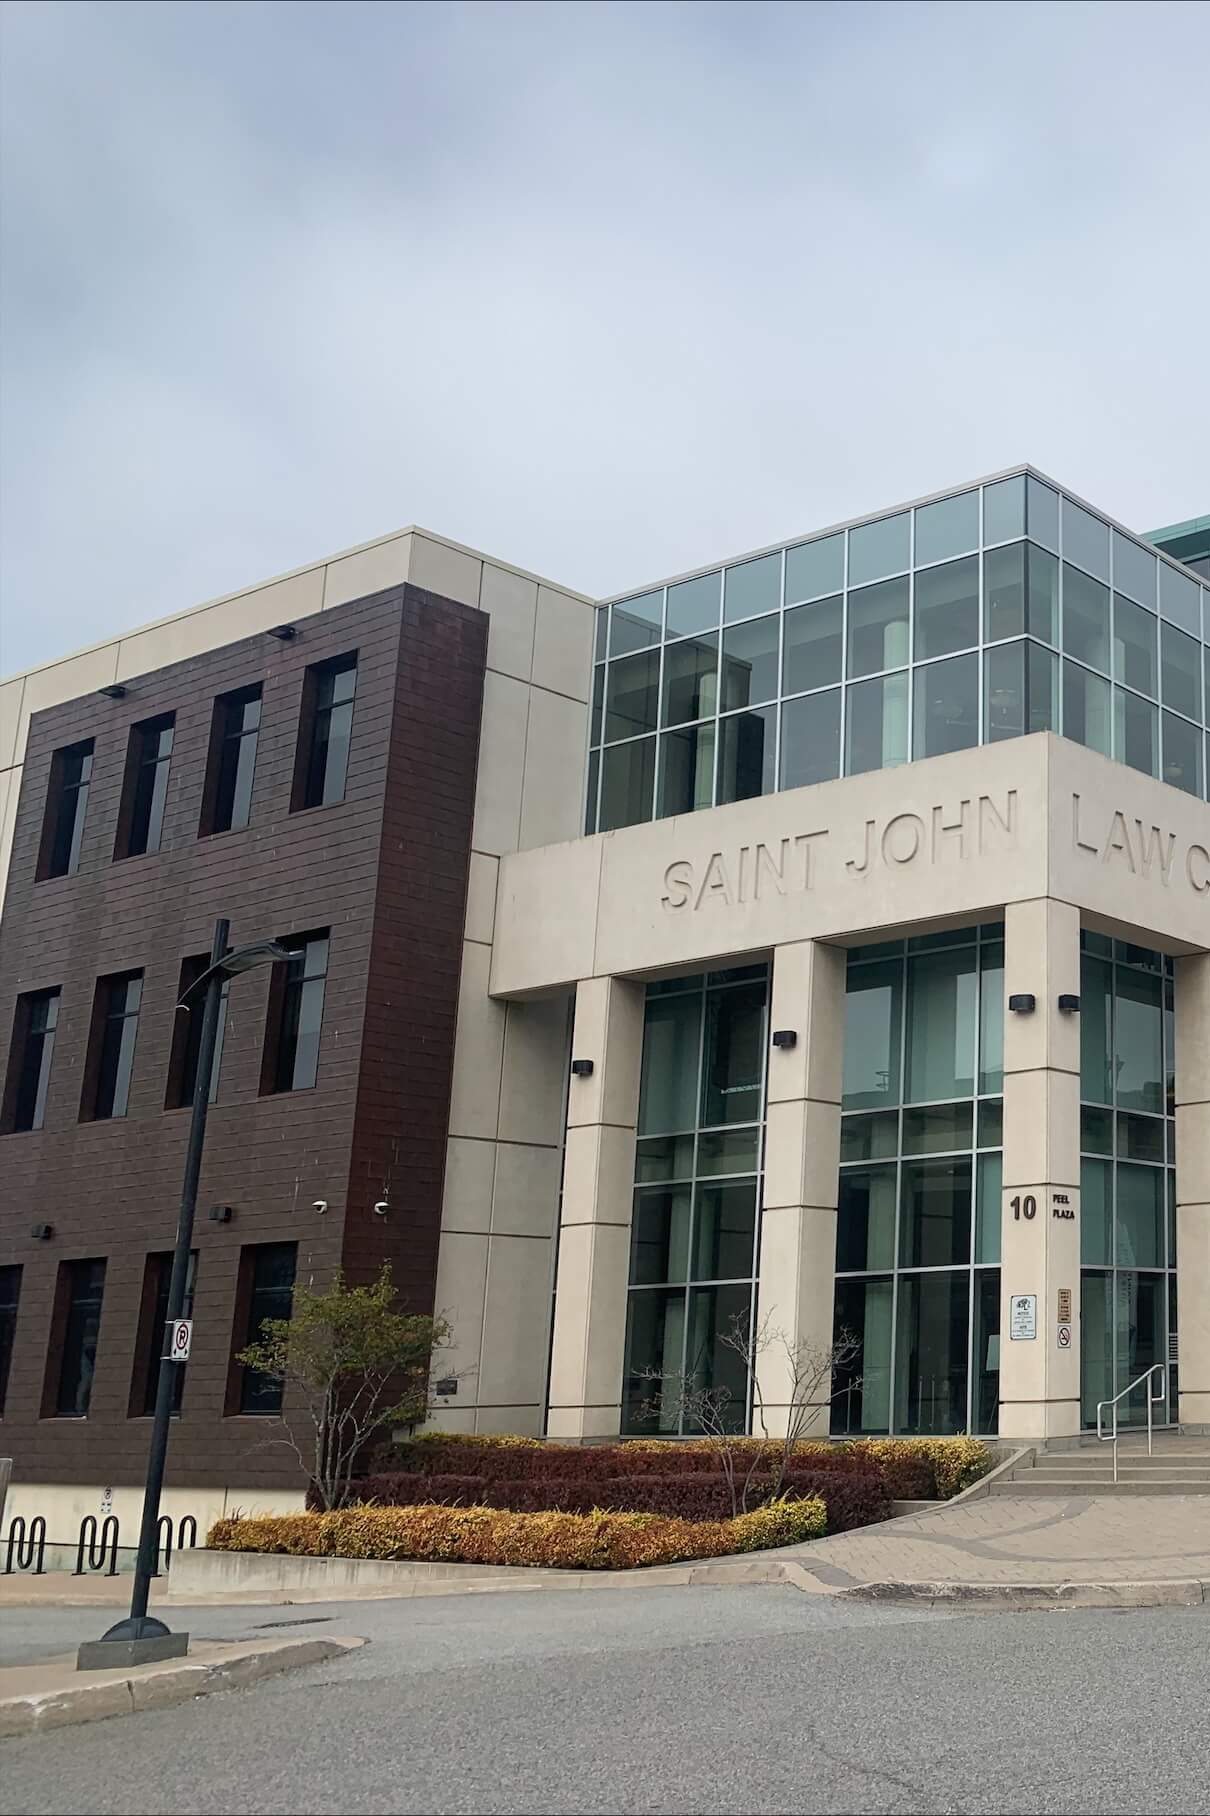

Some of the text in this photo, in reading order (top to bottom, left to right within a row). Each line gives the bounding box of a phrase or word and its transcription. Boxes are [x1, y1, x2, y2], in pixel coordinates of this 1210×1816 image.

[661, 789, 1019, 912] SAINT JOHN
[1072, 793, 1176, 887] LAW
[1010, 1195, 1037, 1220] 10
[1052, 1194, 1070, 1204] PEEL
[1052, 1209, 1075, 1219] PLAZA
